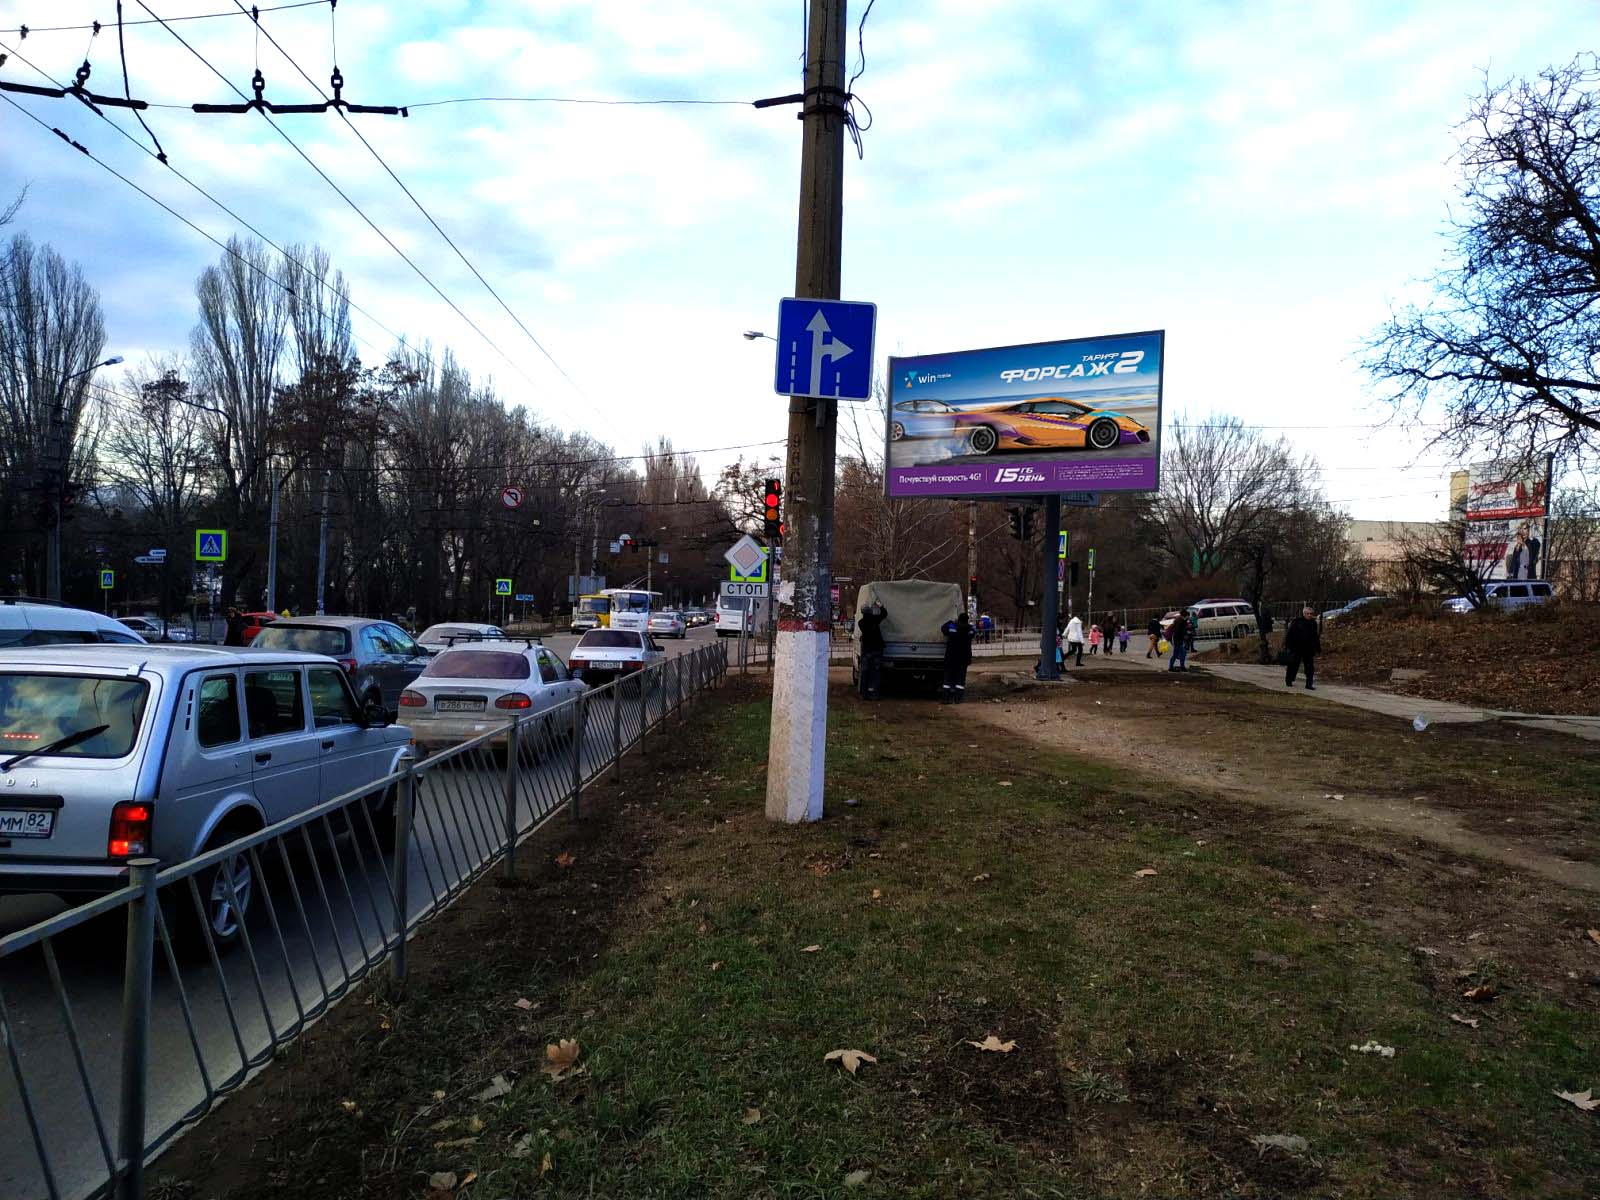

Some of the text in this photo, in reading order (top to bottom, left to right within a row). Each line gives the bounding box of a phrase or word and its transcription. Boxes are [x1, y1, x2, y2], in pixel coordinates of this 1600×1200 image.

[1081, 352, 1120, 362] ТАРИФ
[1000, 350, 1145, 383] ФОРСАЖ 2
[918, 372, 937, 384] win
[899, 472, 982, 484] Почувствуй скорость 4G!
[994, 467, 1021, 483] 15
[727, 583, 763, 596] СТОП
[27, 813, 46, 828] 82
